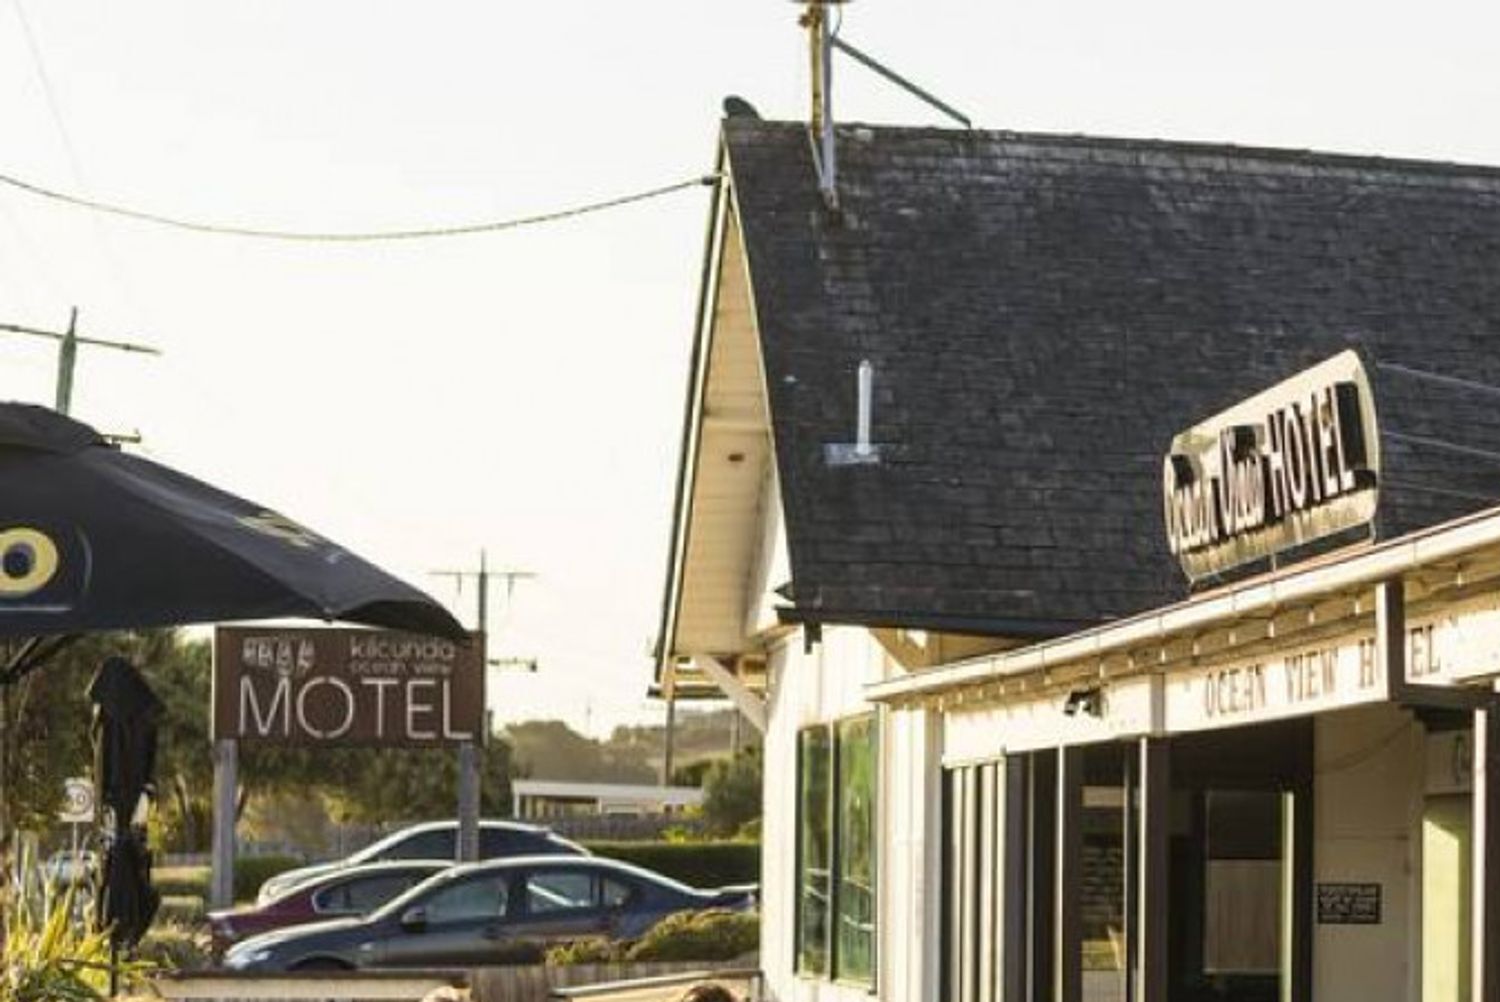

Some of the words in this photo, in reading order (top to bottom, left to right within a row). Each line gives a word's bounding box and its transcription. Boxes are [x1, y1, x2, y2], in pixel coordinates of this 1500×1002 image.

[1265, 379, 1362, 520] HOTEL
[238, 675, 474, 740] MOTEL
[1205, 662, 1266, 717] OCEAN
[1283, 646, 1339, 703] VIEW
[1359, 623, 1441, 689] HEL
